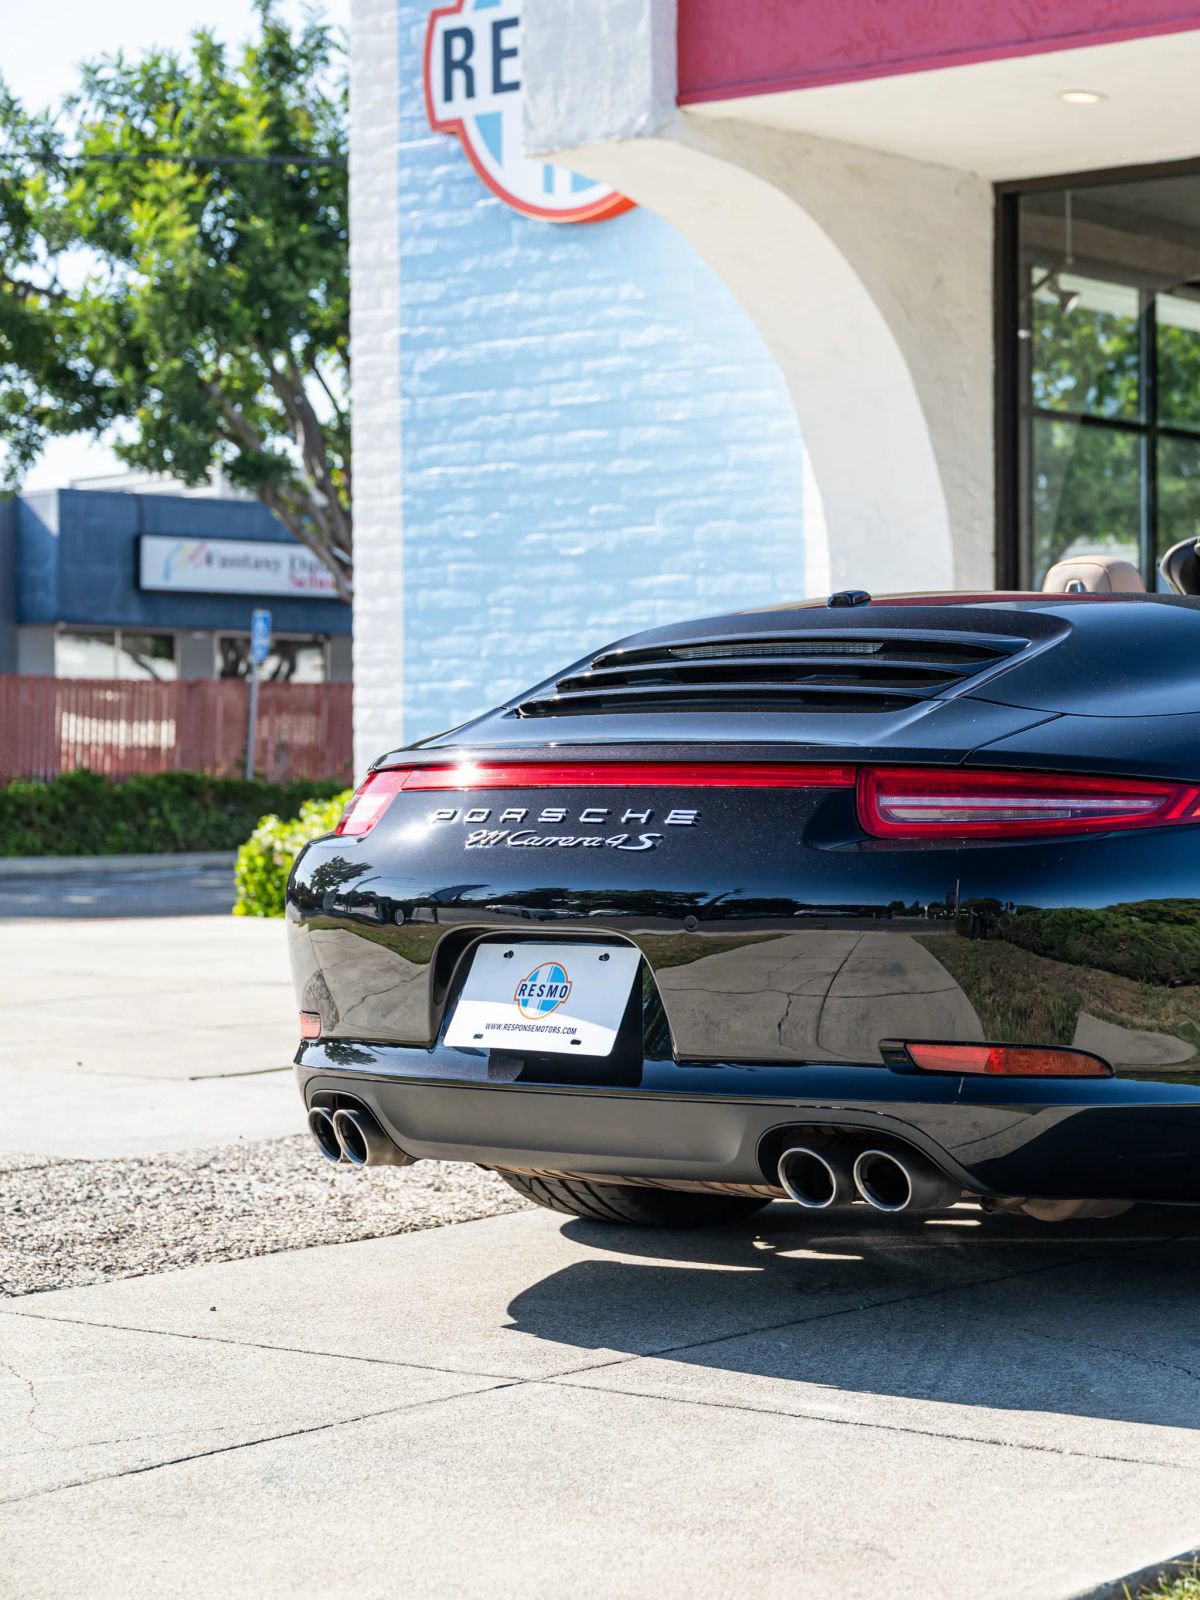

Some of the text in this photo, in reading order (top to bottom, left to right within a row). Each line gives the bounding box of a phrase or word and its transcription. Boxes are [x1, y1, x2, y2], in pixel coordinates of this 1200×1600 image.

[430, 808, 700, 826] PORSCHE
[465, 829, 508, 850] 911
[506, 830, 604, 848] Carrera
[518, 983, 568, 999] RESMO
[485, 1022, 578, 1036] WWW.RESPONSEMOTORS.COM
